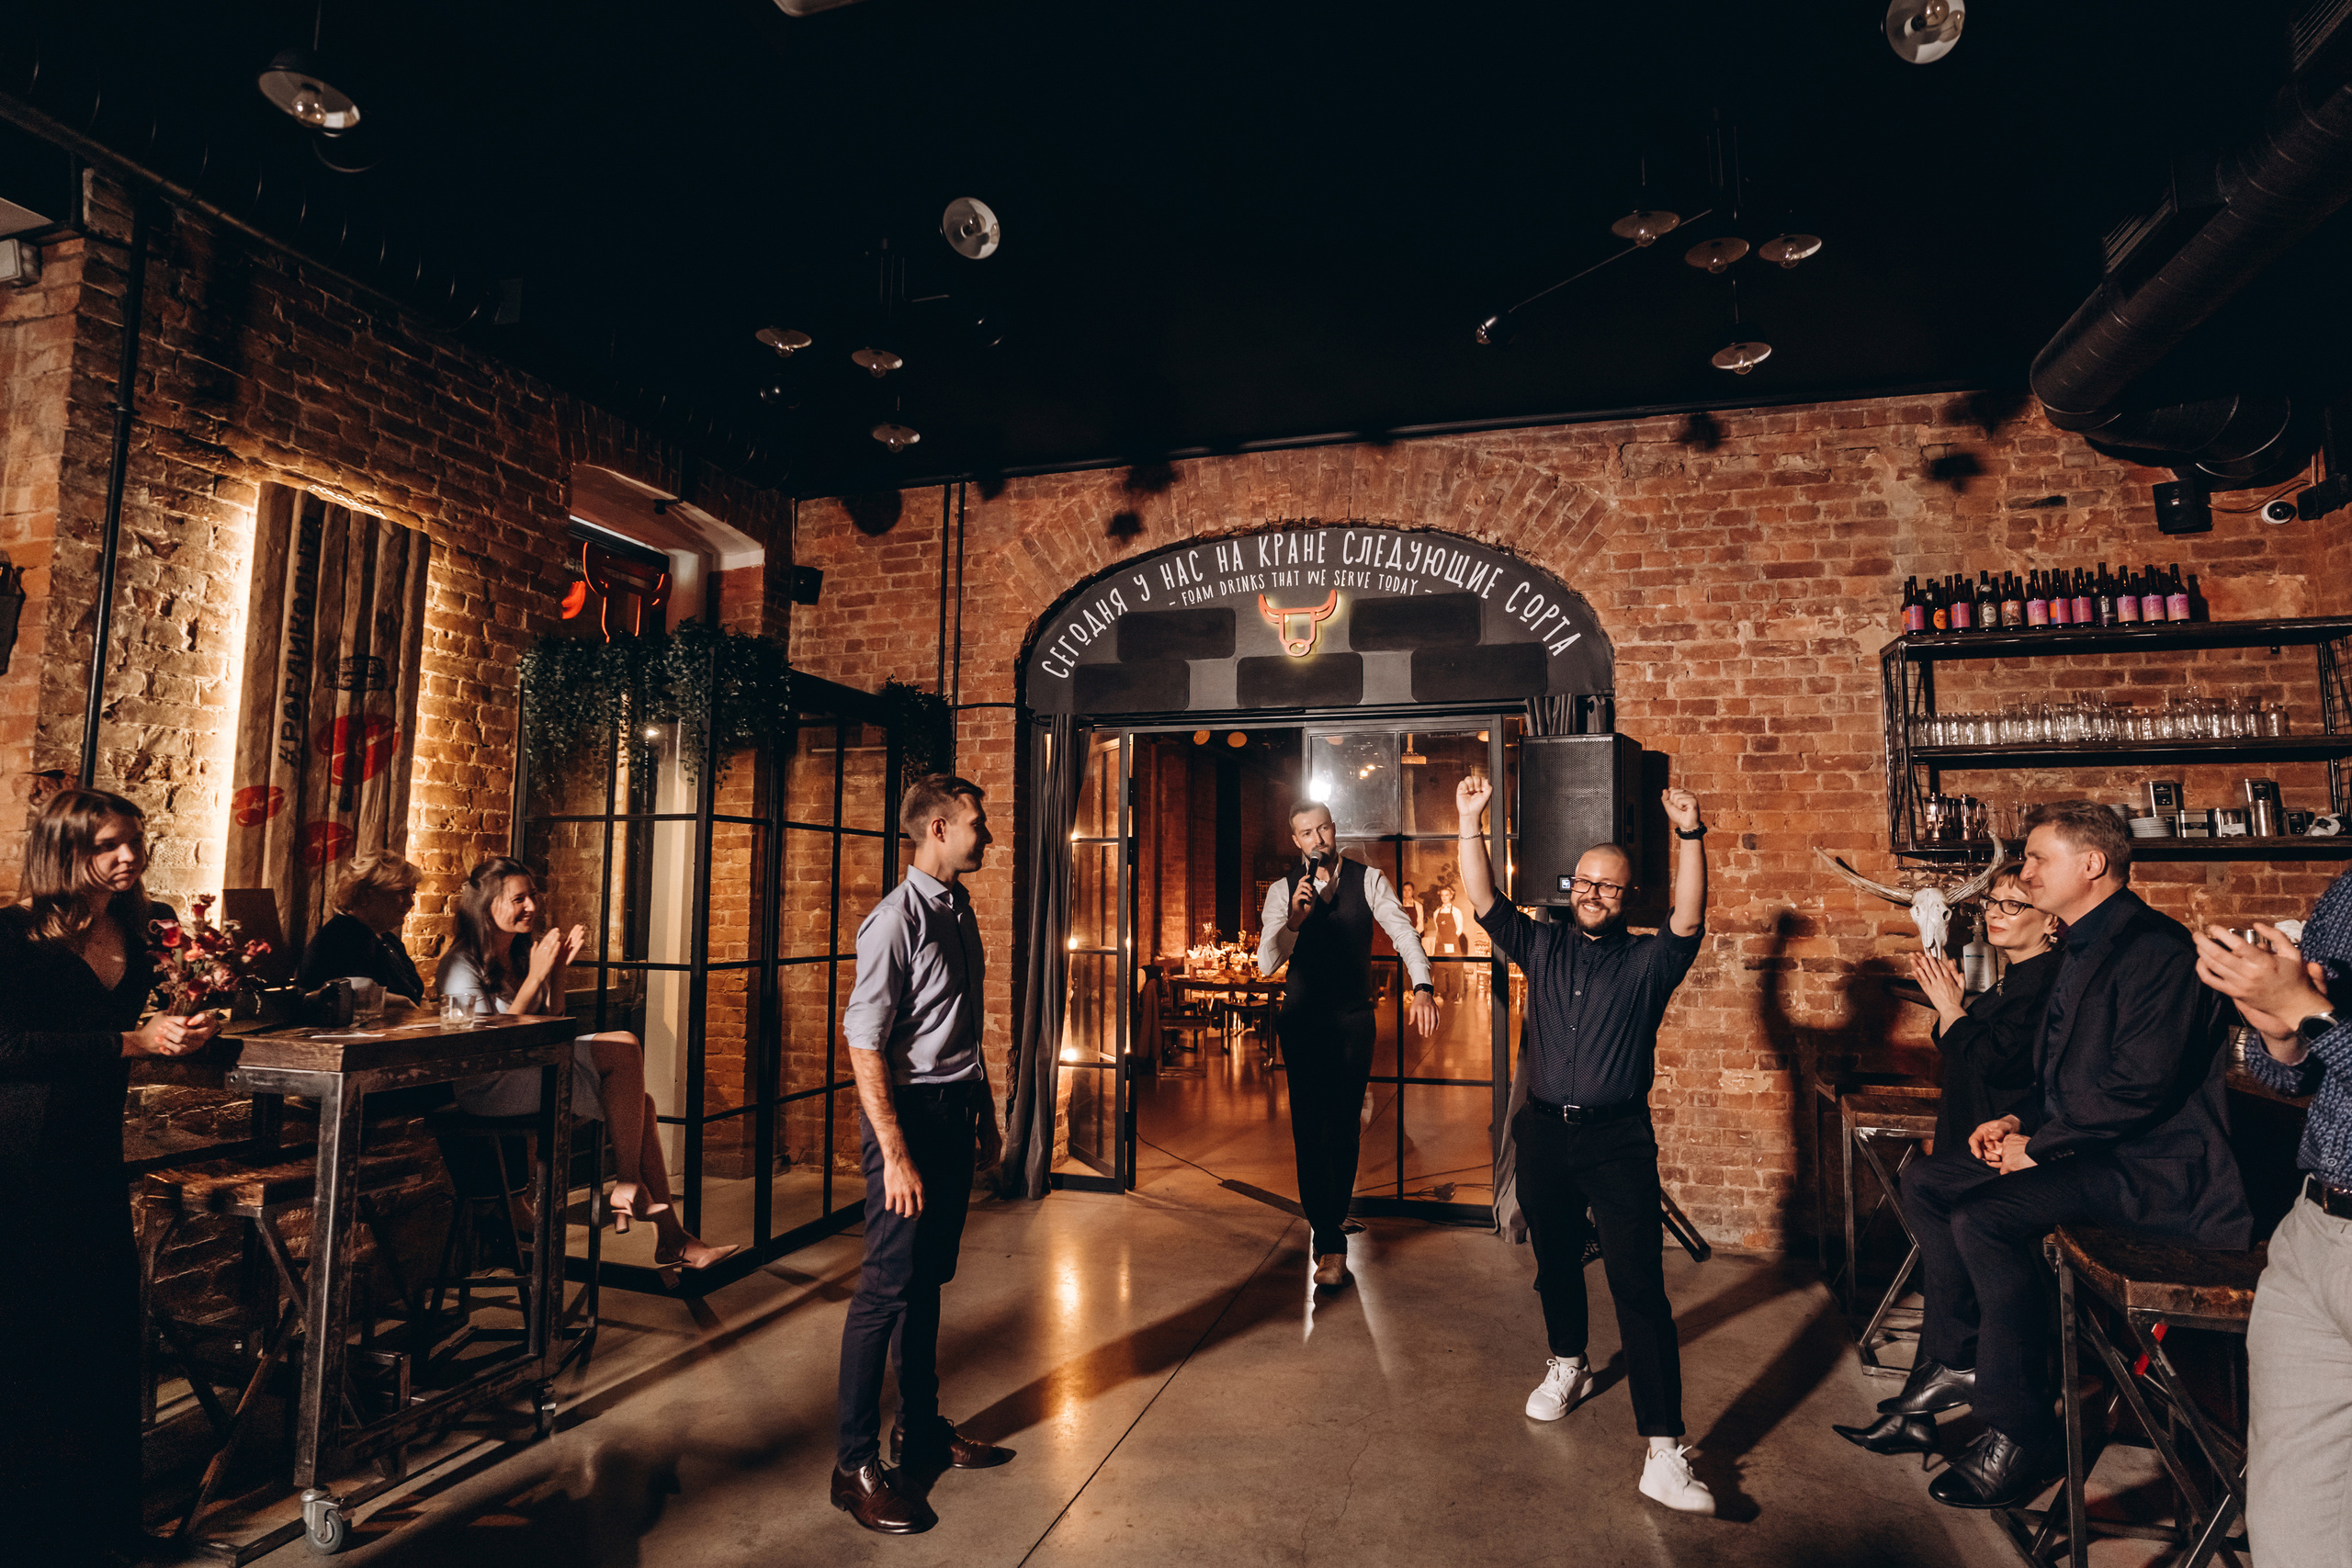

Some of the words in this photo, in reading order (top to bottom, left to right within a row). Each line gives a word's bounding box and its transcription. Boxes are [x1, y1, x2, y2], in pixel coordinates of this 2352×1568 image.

[1041, 587, 1129, 679] СЕГОДНЯ
[1133, 573, 1150, 602] У
[1159, 550, 1204, 591] НАС
[1216, 540, 1244, 573] НА
[1258, 531, 1328, 568] КРАНЕ
[1342, 530, 1504, 600] СЛЕДУЮЩИЕ
[1505, 581, 1581, 657] СОРТА
[1181, 584, 1215, 607] FOAM
[1219, 573, 1265, 596] DRINKS
[1271, 570, 1300, 588] THAT
[1307, 569, 1327, 587] WE
[1333, 570, 1372, 589] SERVE
[1378, 573, 1419, 596] TODAY
